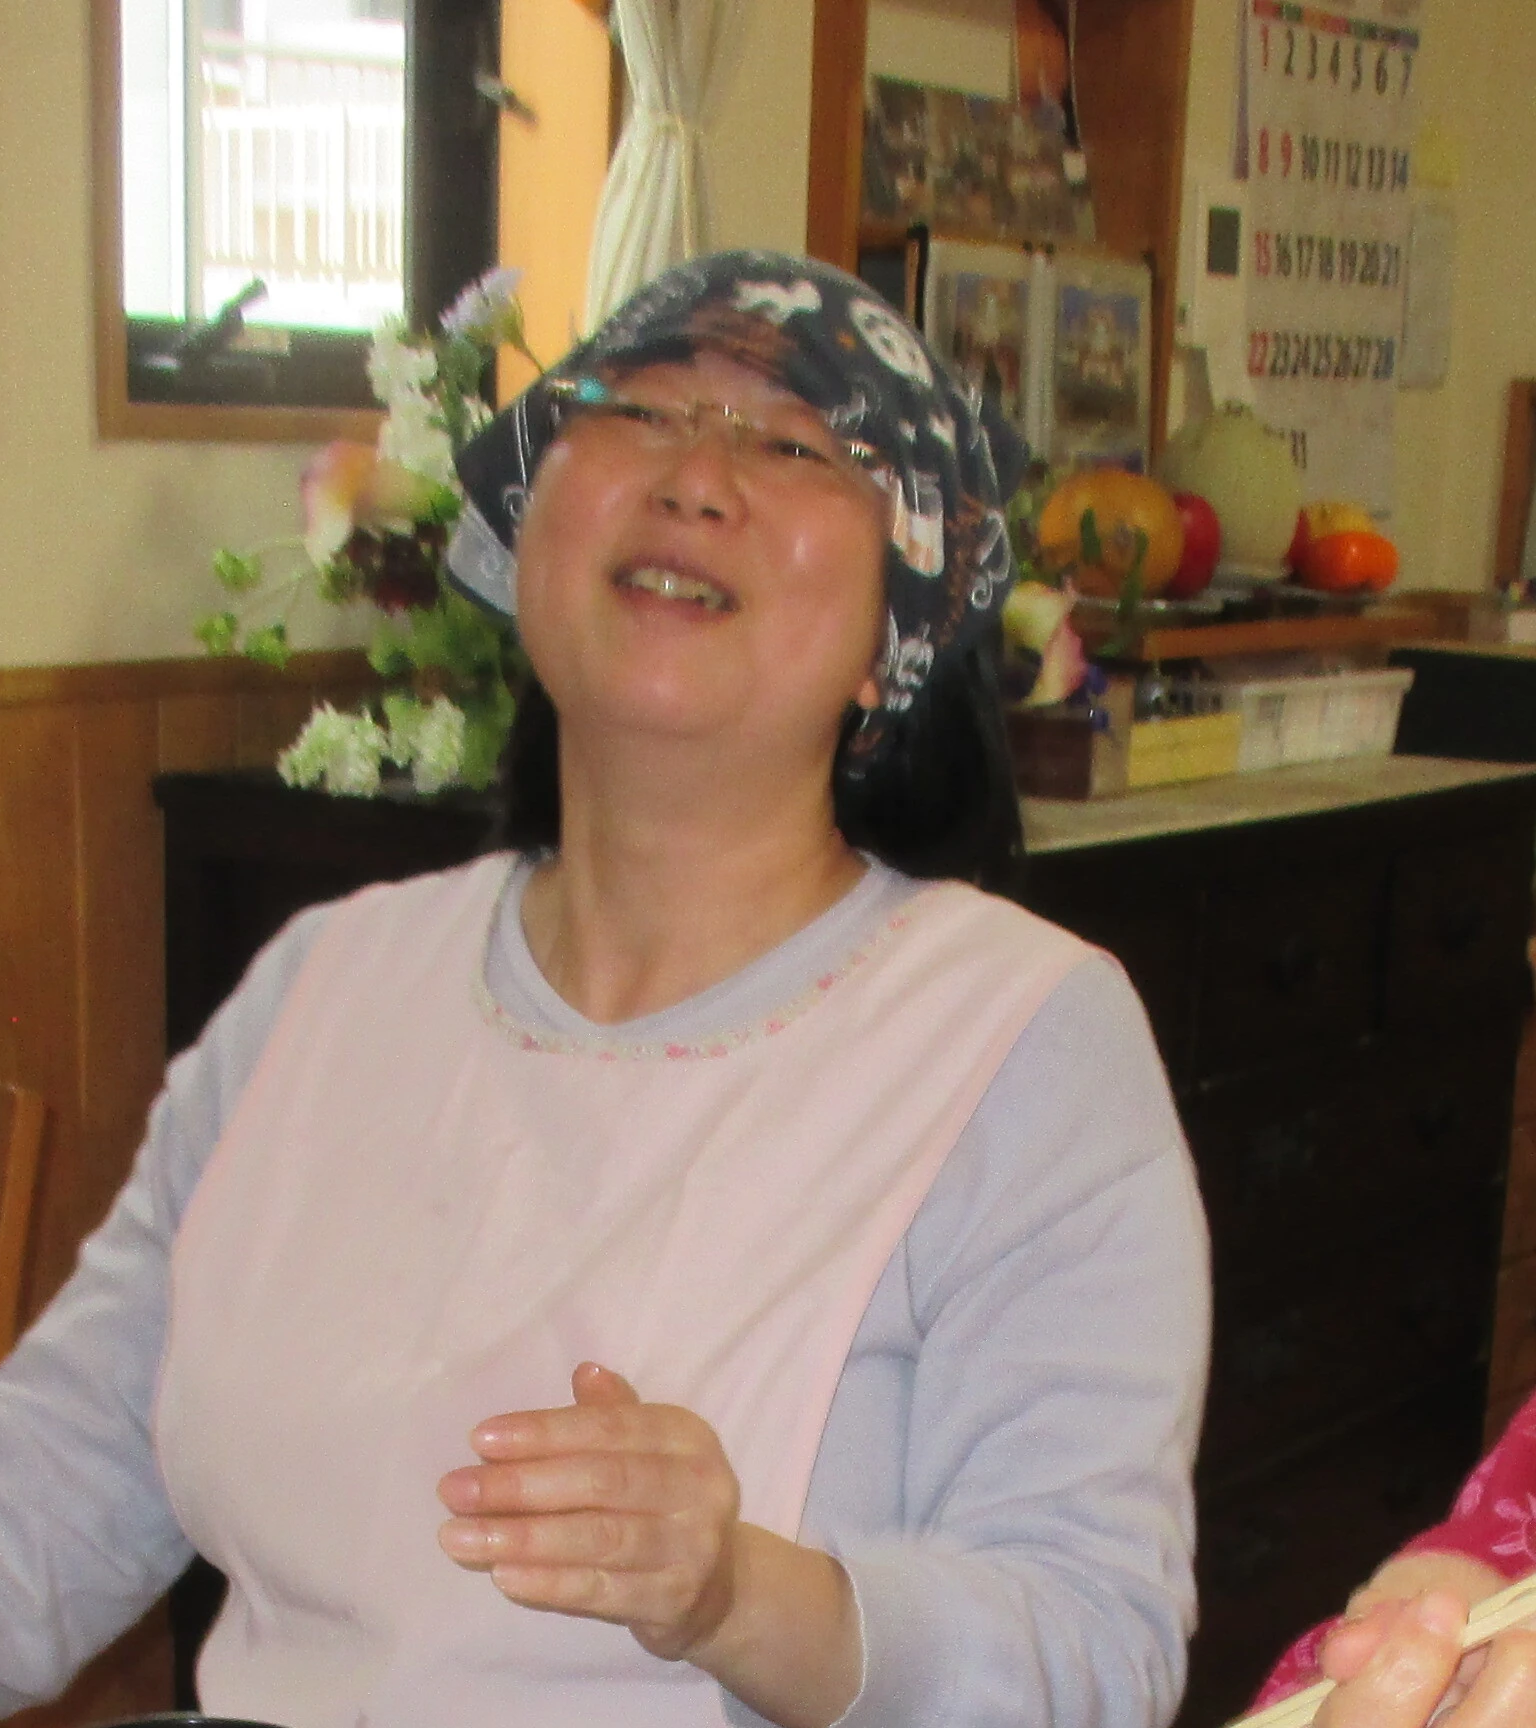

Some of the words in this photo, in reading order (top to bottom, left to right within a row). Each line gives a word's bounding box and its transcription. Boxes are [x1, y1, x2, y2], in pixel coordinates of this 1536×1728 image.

[1284, 28, 1295, 76] 2
[1307, 33, 1318, 81] 3
[1329, 40, 1340, 85] 4
[1352, 42, 1362, 92] 5
[1375, 50, 1388, 96] 6
[1401, 52, 1413, 99] 7
[1259, 128, 1270, 176] 8
[1281, 130, 1293, 178] 9
[1301, 134, 1320, 181] 10
[1325, 137, 1340, 184] 11
[1347, 142, 1362, 188] 12
[1368, 147, 1386, 191] 13
[1390, 147, 1408, 192] 14
[1255, 231, 1271, 276] 15
[1275, 232, 1292, 277] 16
[1297, 234, 1314, 279] 17
[1318, 236, 1334, 281] 18
[1339, 239, 1358, 284] 19
[1359, 241, 1380, 285] 20
[1382, 242, 1400, 286] 21
[1269, 332, 1290, 377] 23
[1291, 332, 1311, 378] 24
[1313, 333, 1332, 378] 25
[1353, 335, 1372, 379] 27
[1373, 336, 1395, 380] 28
